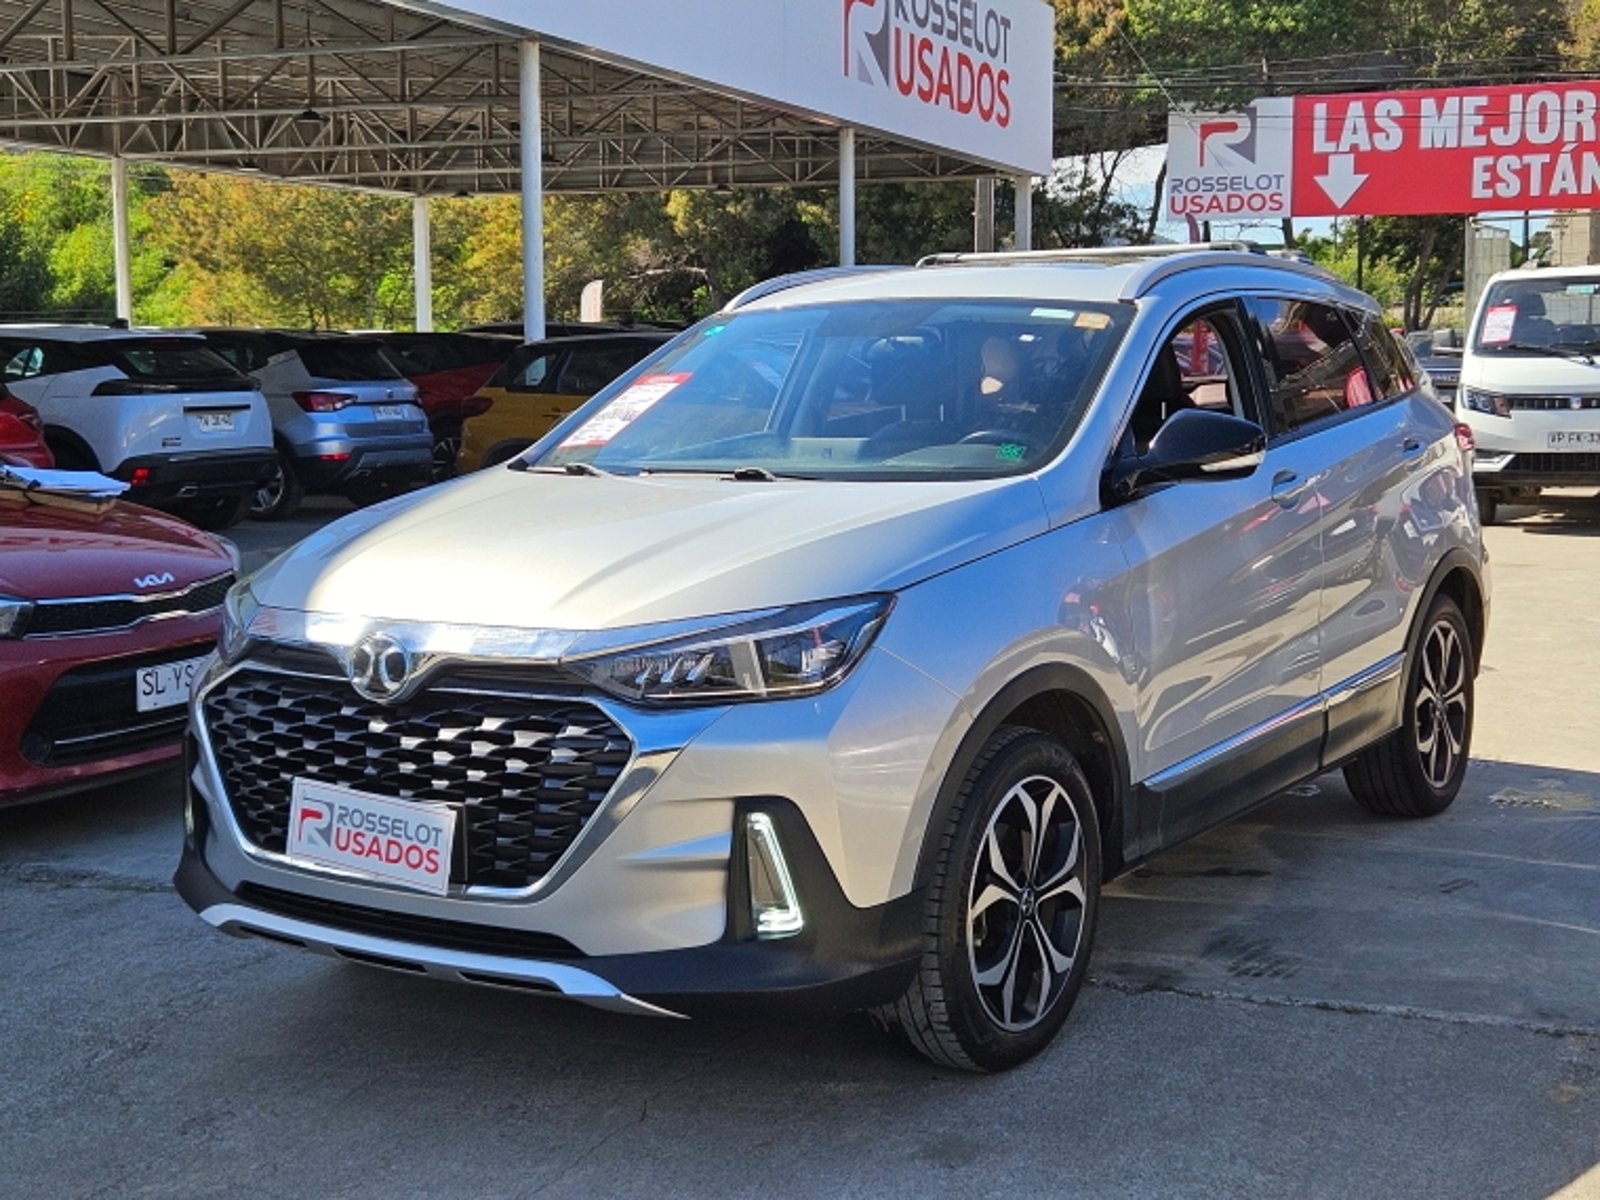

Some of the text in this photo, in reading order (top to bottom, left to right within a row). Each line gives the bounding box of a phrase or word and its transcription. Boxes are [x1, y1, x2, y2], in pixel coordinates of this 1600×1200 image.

[894, 27, 1011, 129] USADOS
[1312, 98, 1404, 154] LAS
[1170, 173, 1285, 194] ROSSELOT
[1170, 193, 1284, 215] USADOS
[336, 805, 444, 847] ROSSELOT
[335, 827, 441, 875] USADOS
